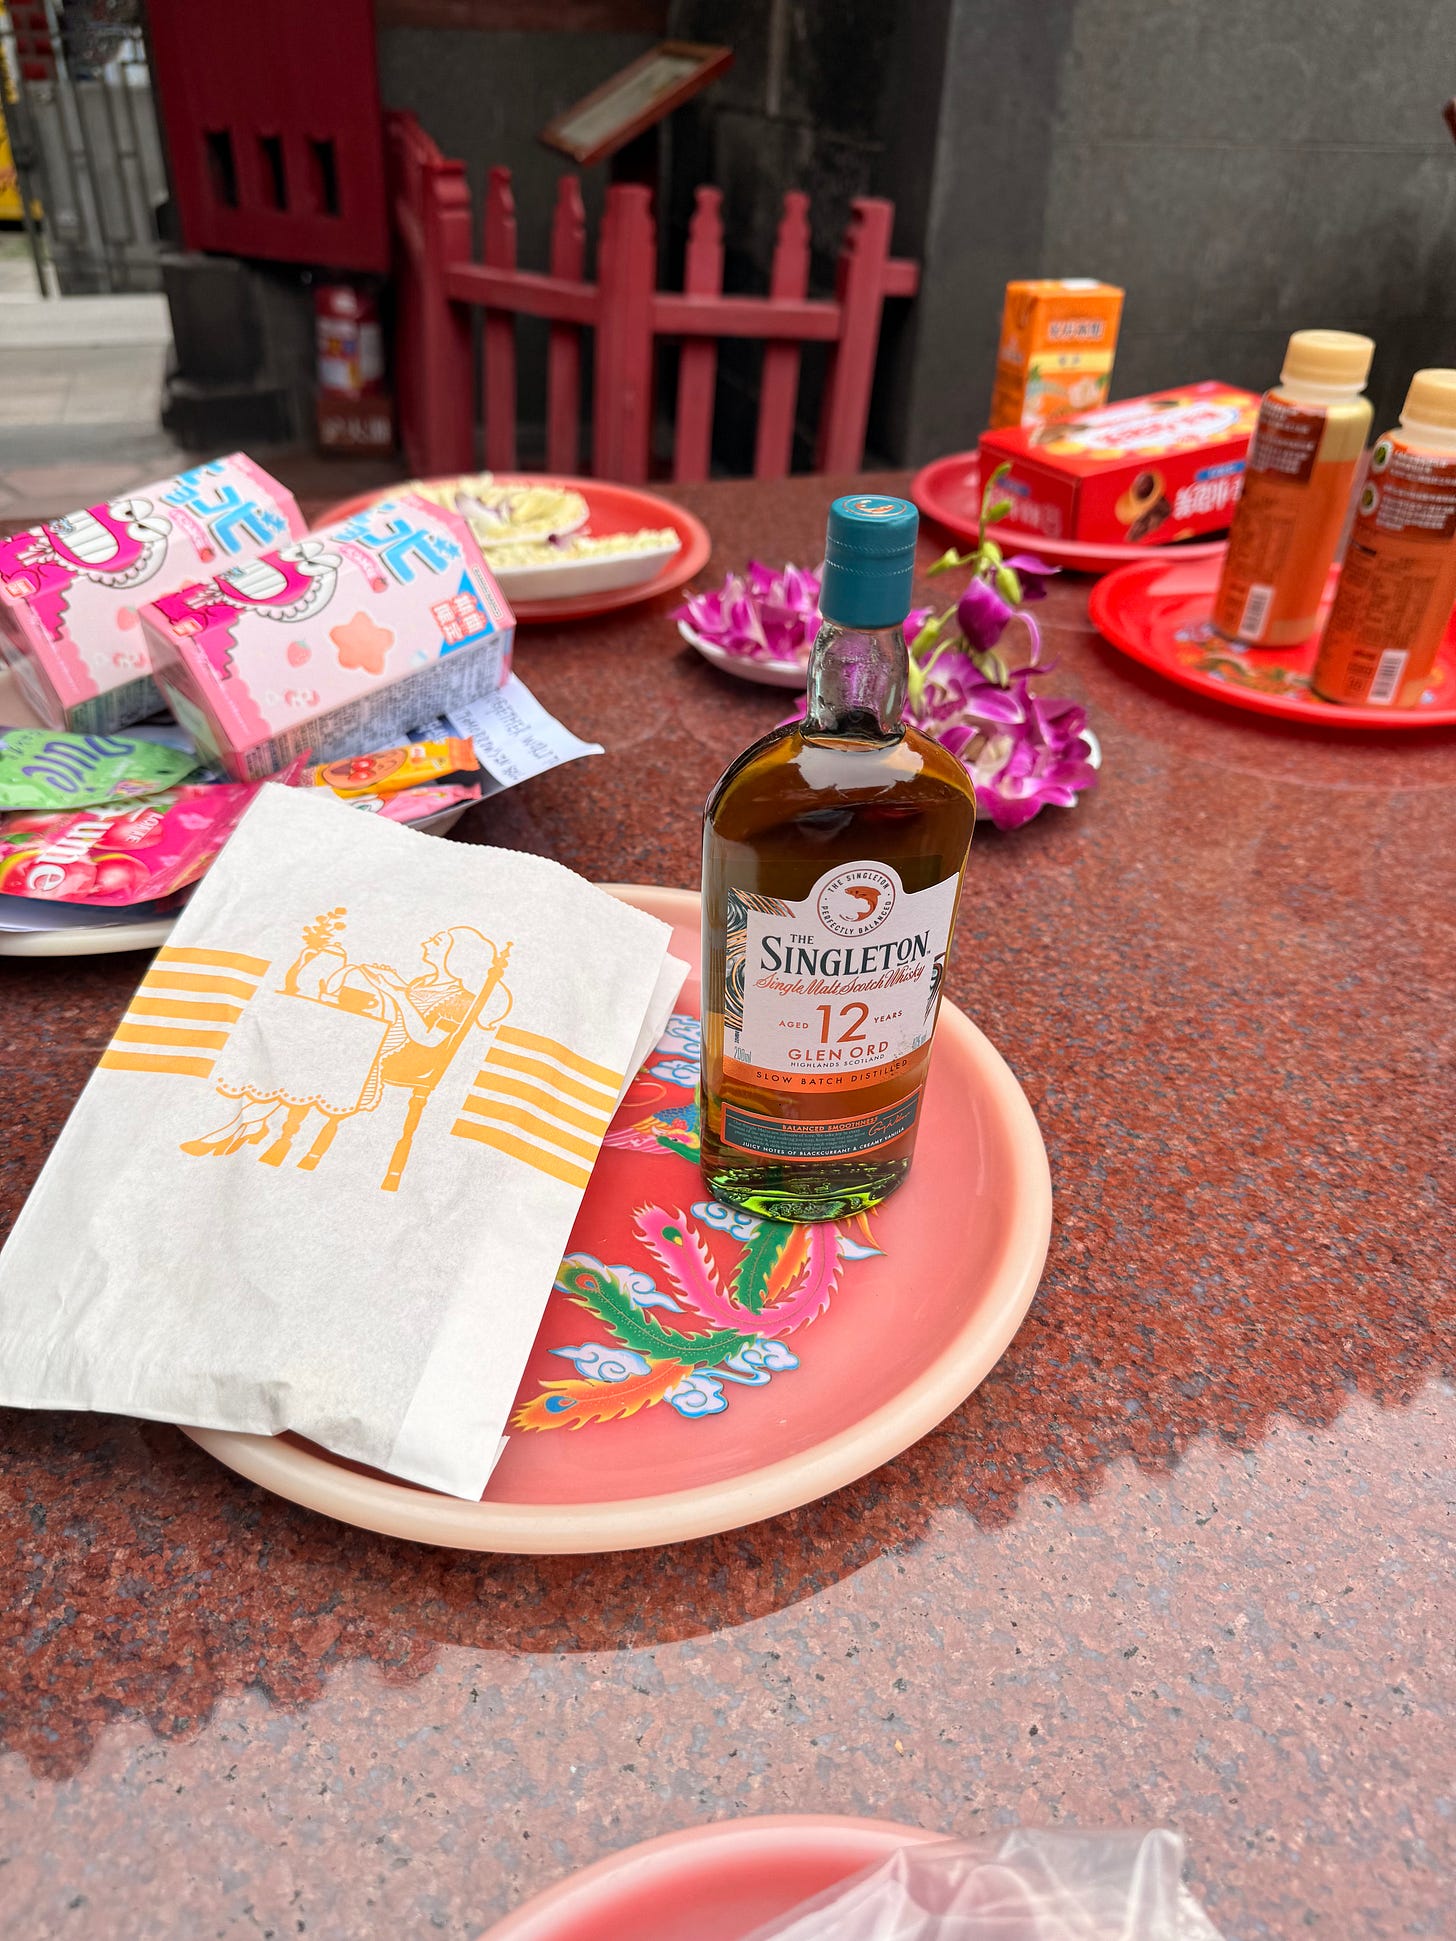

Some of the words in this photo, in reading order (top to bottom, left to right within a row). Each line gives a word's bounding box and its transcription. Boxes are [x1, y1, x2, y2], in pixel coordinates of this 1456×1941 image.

[827, 879, 843, 893] THE
[846, 872, 890, 890] SINGLETON
[821, 905, 854, 935] PERFECTLY
[858, 901, 892, 934] BALANCED
[790, 933, 814, 945] THE
[760, 929, 931, 977] SINGLETON
[753, 972, 804, 997] Single
[800, 976, 841, 996] Malt
[838, 973, 884, 996] Scotch
[881, 961, 926, 989] Whisky
[778, 1019, 809, 1030] AGED
[816, 1001, 870, 1044] 12
[873, 1010, 903, 1024] YEARS
[788, 1048, 841, 1062] GLEN
[849, 1041, 889, 1059] ORD
[790, 1061, 840, 1069] HIGHLANDS
[844, 1054, 885, 1067] SCOTLAND
[756, 1071, 793, 1084] SLOW
[801, 1076, 843, 1086] BATCH
[851, 1059, 908, 1083] DISTILLED
[782, 1124, 825, 1132] BALANCED
[827, 1116, 879, 1132] SMOOTHNESS
[742, 1141, 761, 1150] JUICY
[763, 1147, 785, 1155] NOTES
[799, 1147, 850, 1156] BLACKCURRANT
[859, 1138, 883, 1149] CREAMY
[884, 1126, 905, 1141] VANILLA
